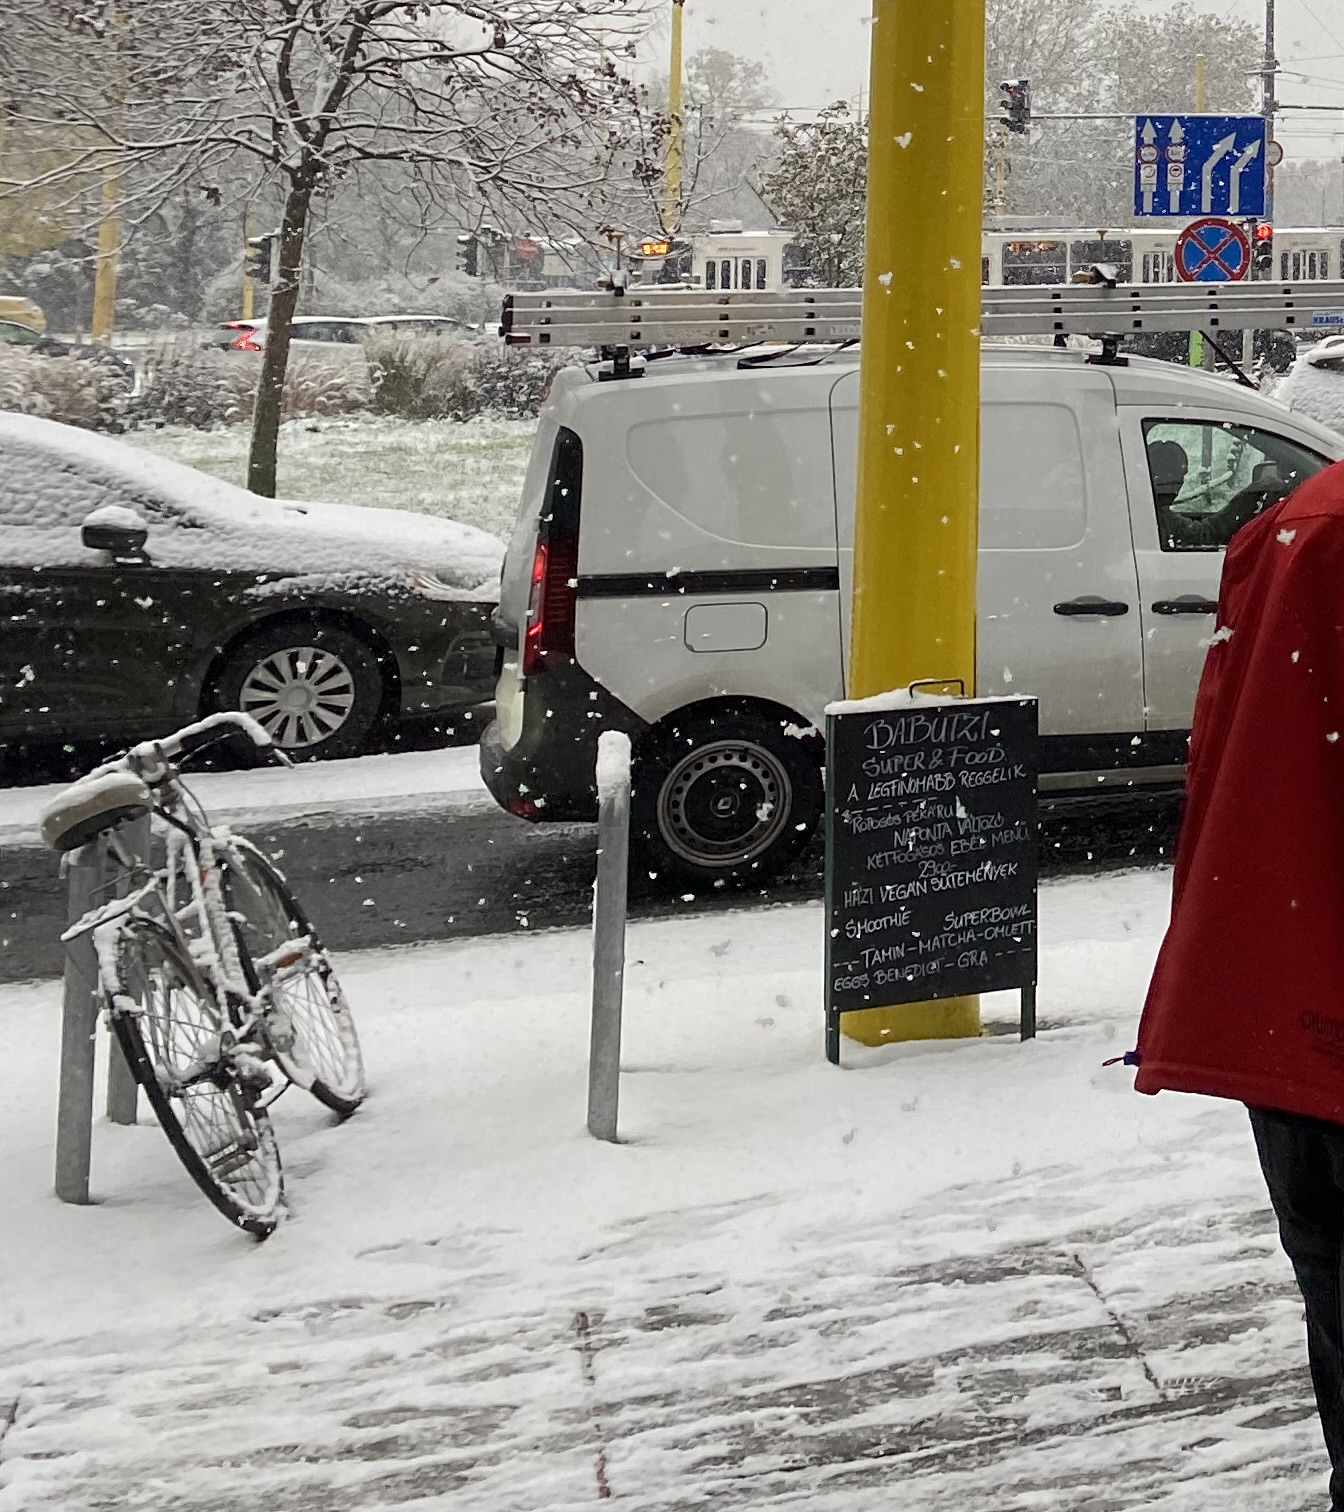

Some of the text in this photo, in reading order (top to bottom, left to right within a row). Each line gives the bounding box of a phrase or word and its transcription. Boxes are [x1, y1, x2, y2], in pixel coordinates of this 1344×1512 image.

[864, 711, 990, 750] BABUTZI
[862, 746, 1006, 778] SUPER & FOOD
[847, 783, 859, 802] A
[959, 764, 1026, 788] REGGELIK
[894, 822, 952, 848] NAPONTA
[844, 882, 874, 908] HÁZI
[931, 861, 1018, 891] SÜTEMÉNYEK
[845, 911, 912, 938] SMOOTHIE
[834, 975, 870, 991] EGGS
